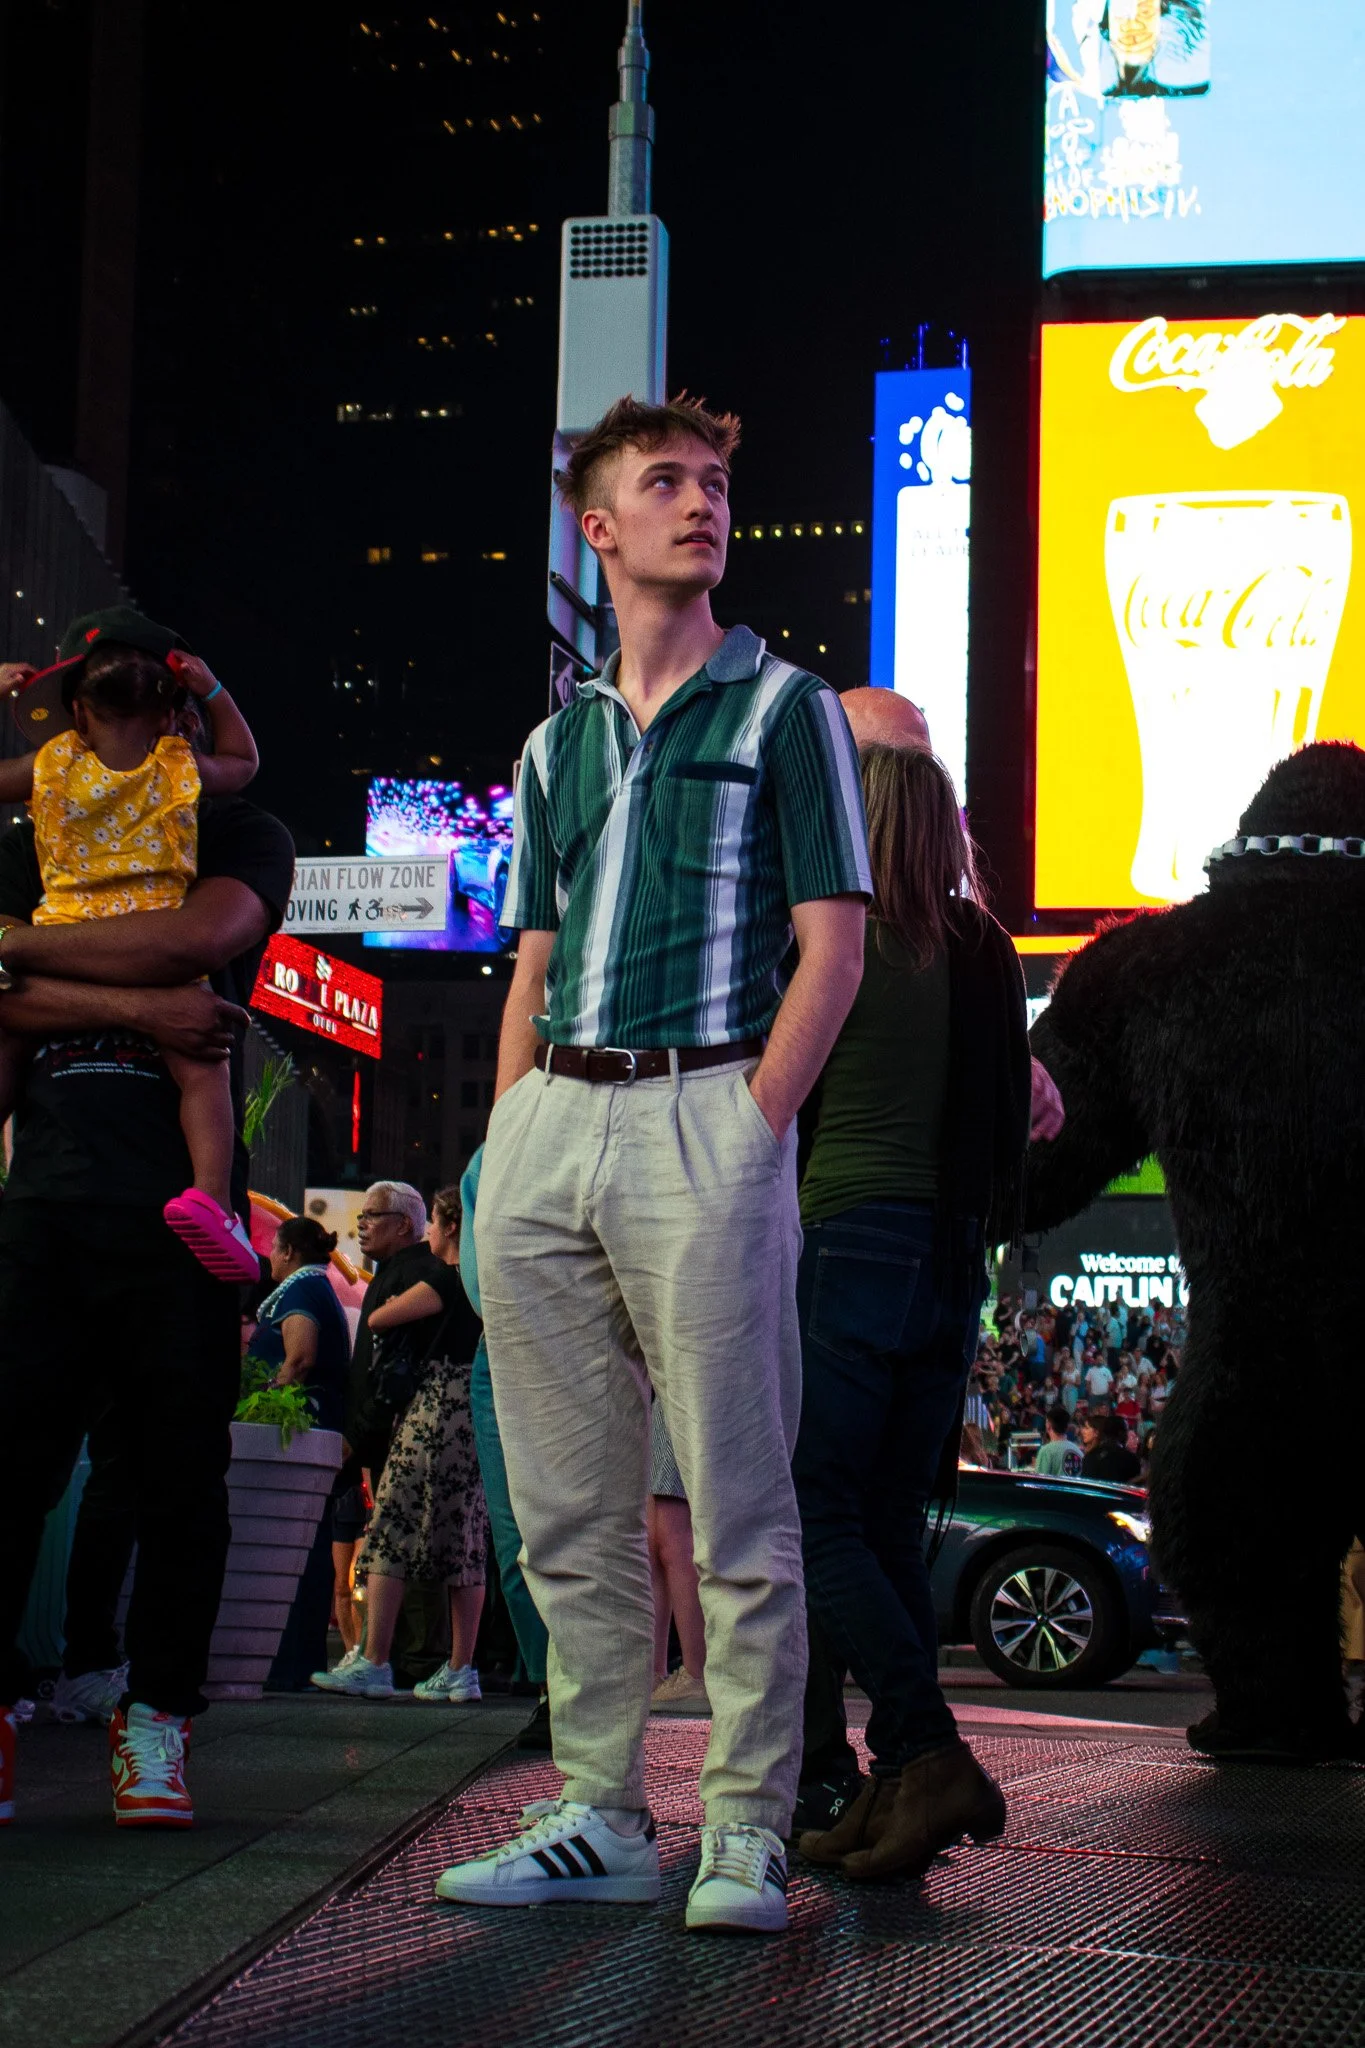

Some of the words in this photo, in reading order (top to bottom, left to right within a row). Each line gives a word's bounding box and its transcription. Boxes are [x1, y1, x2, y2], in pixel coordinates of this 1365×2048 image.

[1109, 313, 1348, 392] Coca-Cola
[337, 867, 384, 890] FLOW
[390, 866, 436, 889] ZONE
[334, 989, 379, 1030] PLAZA
[1080, 1252, 1166, 1273] Welcome
[1050, 1275, 1173, 1308] CAITLIN
